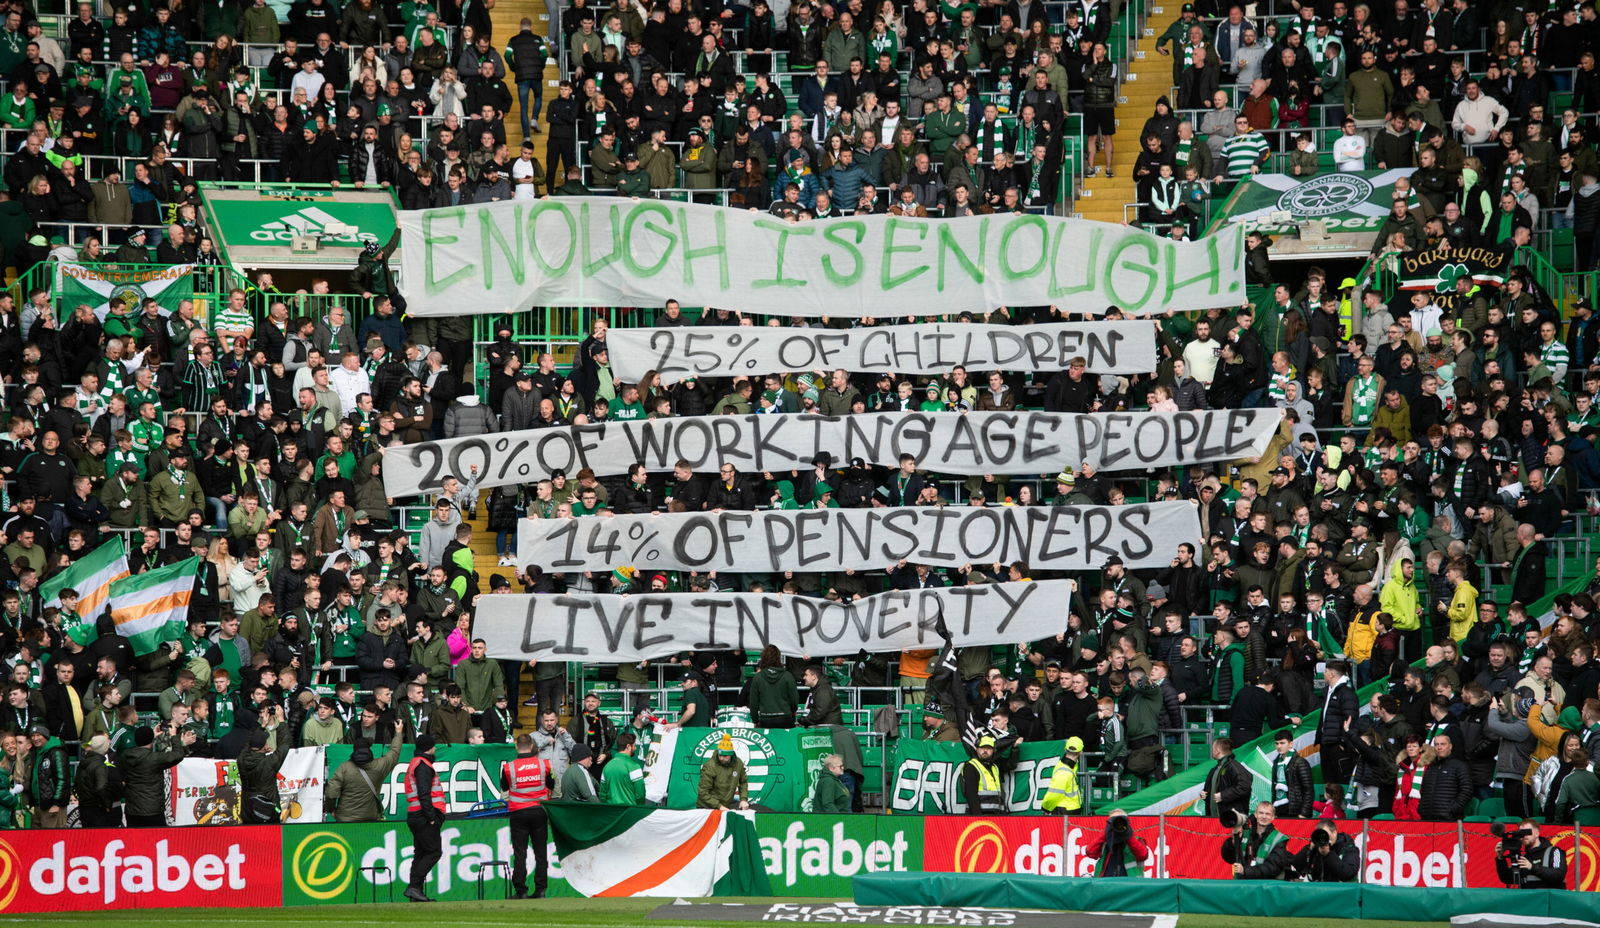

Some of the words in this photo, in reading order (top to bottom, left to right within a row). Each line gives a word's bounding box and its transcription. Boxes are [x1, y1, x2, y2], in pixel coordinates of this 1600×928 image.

[250, 228, 379, 242] adas
[423, 201, 729, 294] ENOUGH
[751, 220, 866, 287] IS
[881, 214, 1241, 310] ENOUGH!
[61, 265, 130, 281] COVENTRY
[133, 265, 193, 282] EMERALD
[650, 330, 759, 373] 25%
[779, 332, 849, 368] OF
[860, 325, 1123, 369] CHILDREN
[409, 438, 529, 490] 20%
[536, 423, 605, 477] OF
[622, 414, 936, 470] WORKING
[941, 411, 1061, 464] AGE
[1074, 409, 1257, 466] PEOPLE
[544, 519, 660, 566] 14%
[673, 511, 753, 567] OF
[764, 505, 1151, 570] PENSIONERS
[521, 597, 673, 655] LIVE
[691, 597, 781, 648] IN
[790, 582, 1037, 647] POVERTY
[694, 730, 728, 757] GREEN
[731, 728, 776, 758] BRIGADE
[177, 786, 216, 799] TERNI
[516, 774, 541, 783] RESPONSE
[893, 756, 1061, 814] BRIDE
[29, 839, 246, 904] dafabet
[759, 821, 909, 887] afabet
